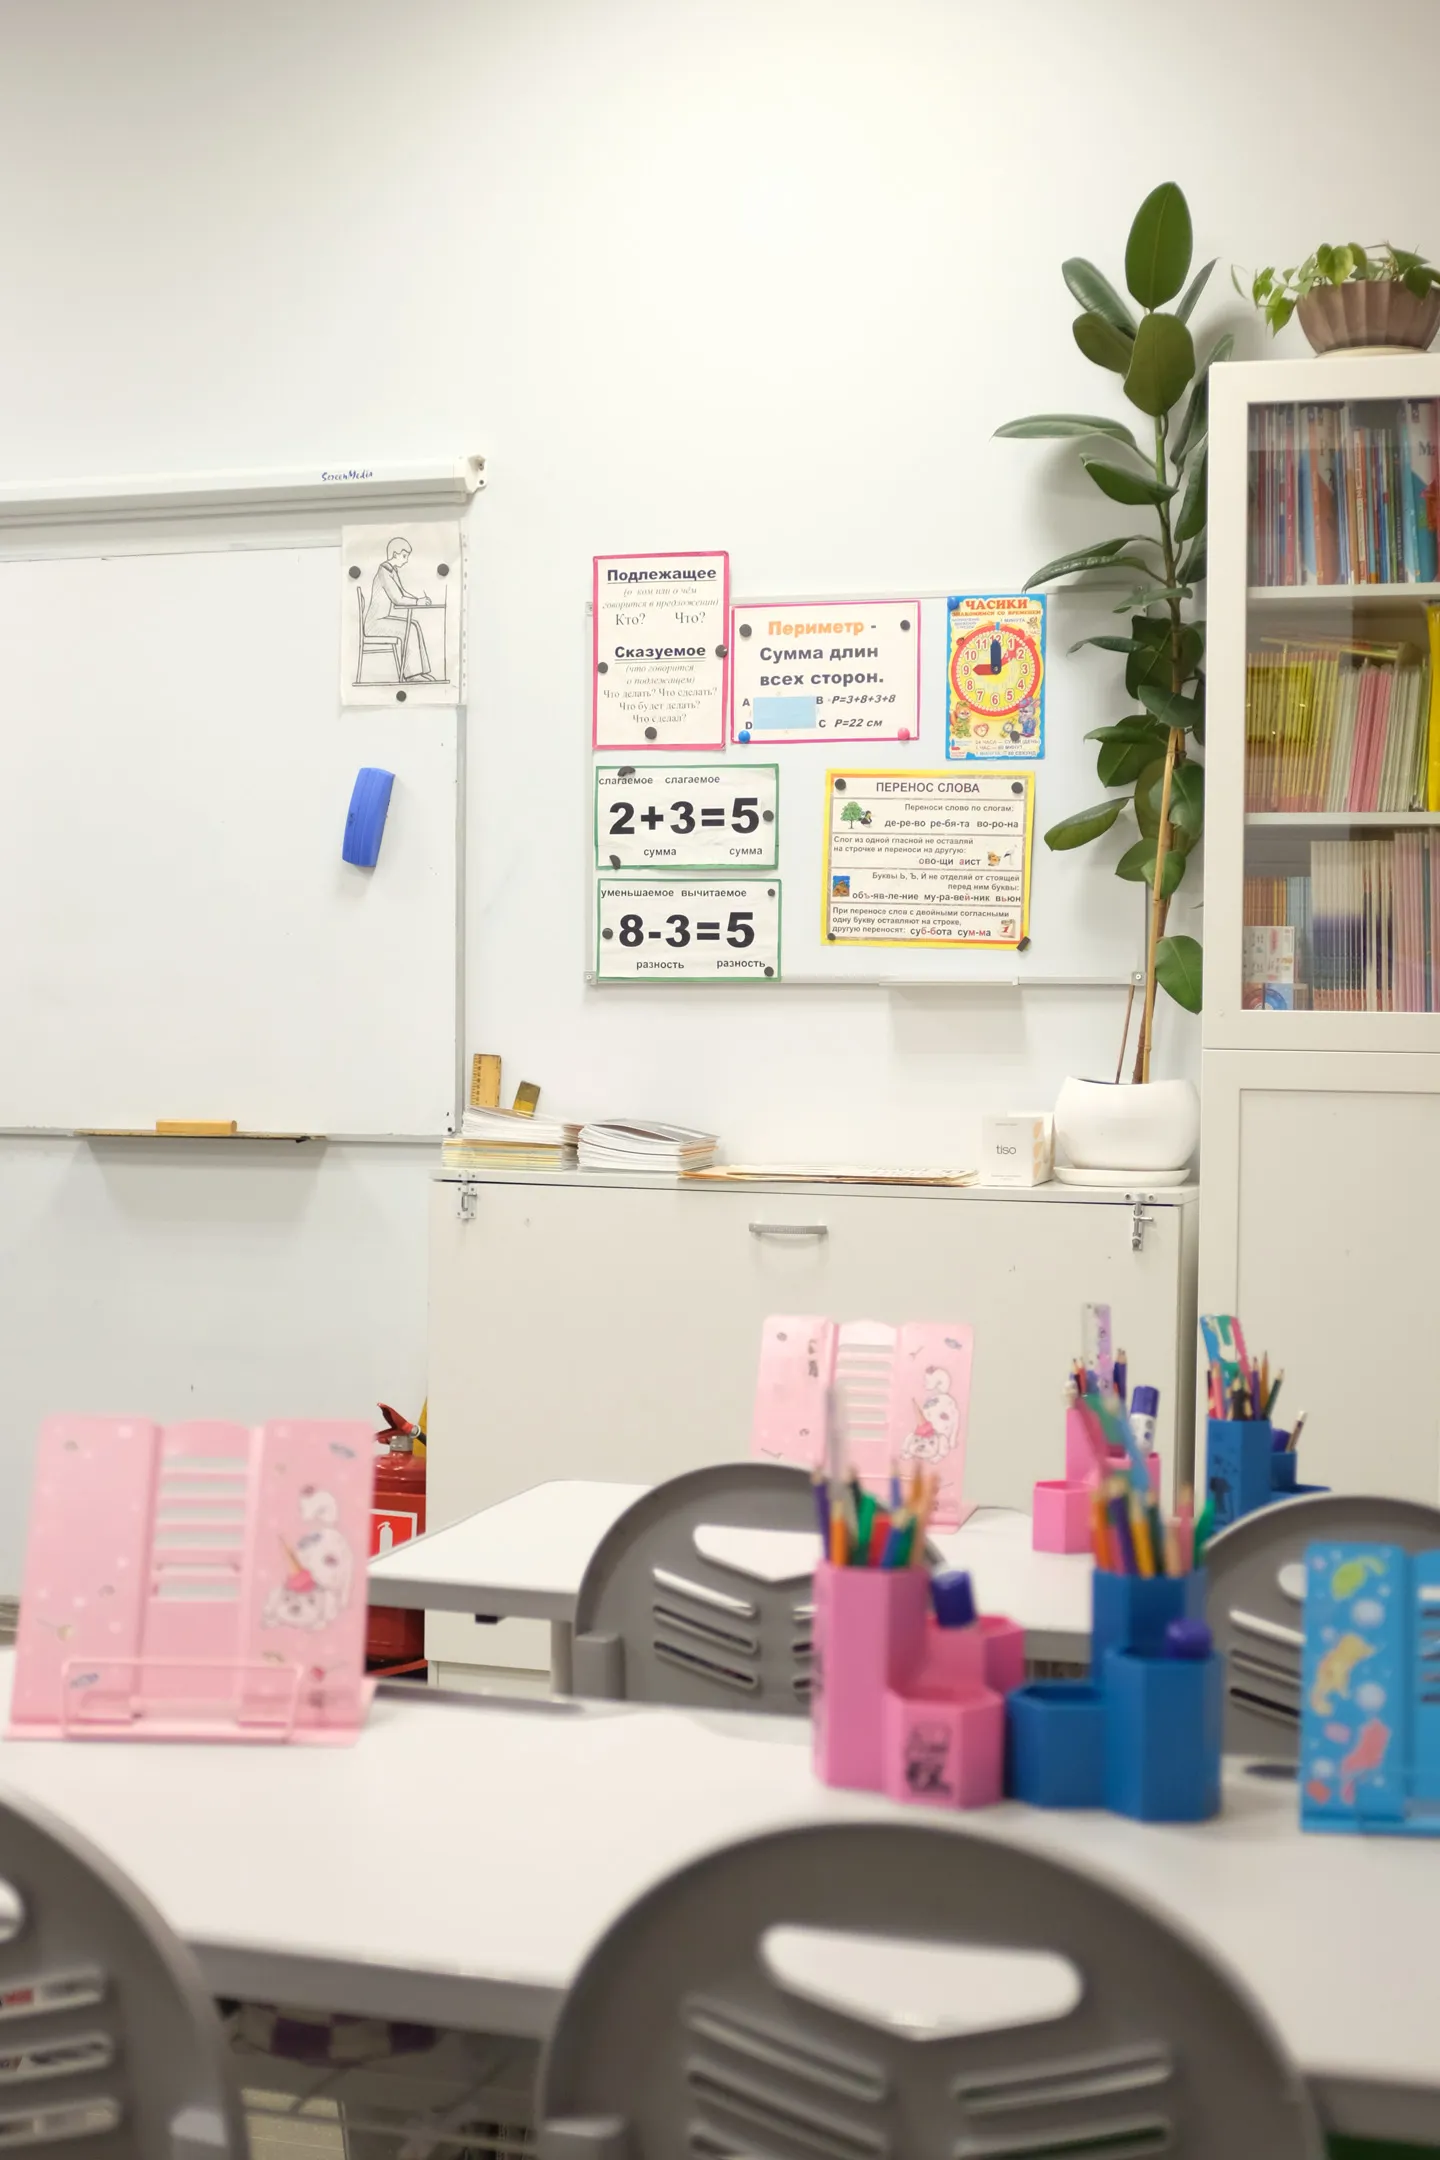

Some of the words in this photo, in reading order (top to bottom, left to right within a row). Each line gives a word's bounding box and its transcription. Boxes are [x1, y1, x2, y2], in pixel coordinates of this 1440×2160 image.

[322, 470, 373, 482] ScreenMedia
[607, 569, 716, 583] Подлежащее
[965, 599, 1028, 610] ЧАСИКИ
[616, 613, 646, 625] Кто?
[675, 612, 706, 623] Что?
[768, 620, 864, 638] Периметр
[976, 639, 987, 649] 11
[1008, 639, 1013, 648] 1
[615, 646, 706, 659] Сказуемое
[760, 647, 823, 664] Сумма
[829, 647, 878, 661] длин
[965, 651, 976, 660] 10
[1018, 650, 1024, 659] 2
[963, 665, 969, 675] 9
[1022, 664, 1028, 674] 3
[760, 674, 804, 686] всех
[810, 672, 884, 687] сторон.
[1018, 680, 1024, 689] 4
[967, 680, 973, 690] 8
[603, 690, 620, 698] Что
[622, 689, 656, 698] делать?
[658, 688, 675, 697] Что
[678, 687, 717, 697] сделать?
[977, 691, 983, 700] 7
[1007, 691, 1012, 700] 5
[832, 694, 896, 704] P=3+8+3+8
[992, 695, 998, 704] 6
[619, 702, 636, 711] Что
[638, 701, 664, 712] будет
[666, 700, 700, 710] делать?
[633, 714, 649, 723] Что
[652, 714, 686, 723] сделал?
[834, 719, 864, 728] P=22
[745, 722, 753, 730] D
[598, 776, 653, 785] слагаемое
[665, 775, 720, 784] слагаемое
[876, 782, 934, 793] ПЕРЕНОС
[937, 783, 980, 793] СЛОВА
[609, 797, 760, 835] 2+3=5
[884, 820, 926, 828] де-ре-во
[930, 819, 970, 830] ре-бя-та
[976, 820, 1019, 830] во-ро-на
[834, 836, 853, 844] Слог
[865, 836, 890, 845] одной
[892, 836, 923, 845] гласной
[644, 848, 677, 858] сумма
[729, 847, 763, 857] сумма
[601, 890, 674, 899] уменьшаемое
[681, 889, 747, 897] вычитаемое
[924, 893, 990, 902] му-ра-вей-ник
[853, 916, 875, 925] букву
[619, 912, 755, 948] 8-3=5
[910, 926, 952, 936] суб-бота
[957, 929, 991, 937] сум-ма
[636, 960, 684, 970] разность
[717, 959, 766, 969] разность
[996, 1144, 1017, 1155] tiso
